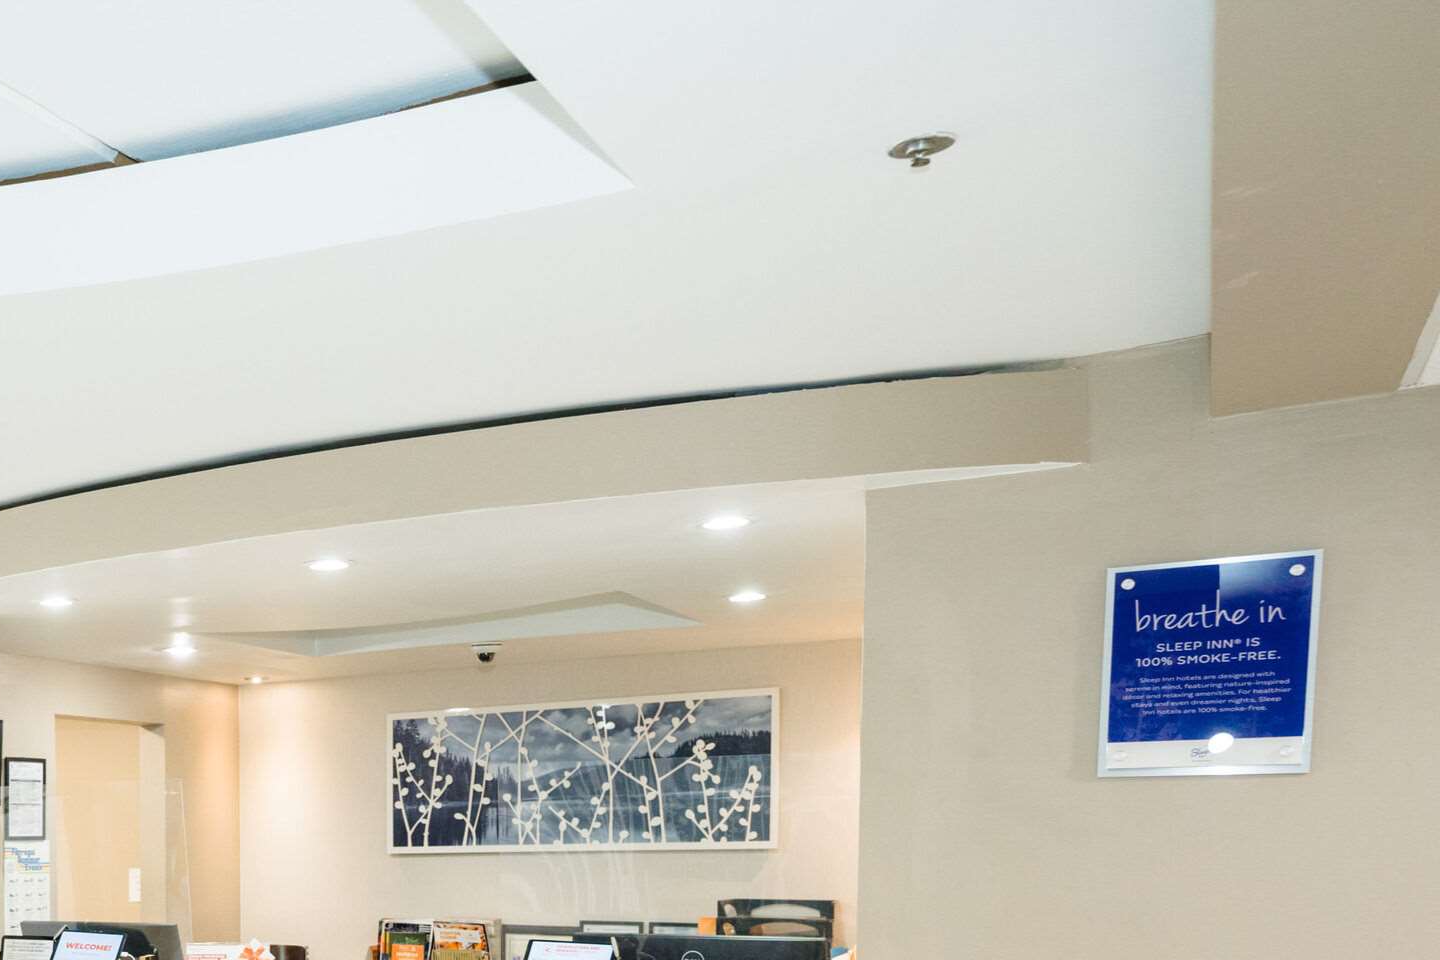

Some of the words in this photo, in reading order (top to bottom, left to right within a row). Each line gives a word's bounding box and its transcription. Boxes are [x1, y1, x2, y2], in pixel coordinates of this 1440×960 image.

[1135, 589, 1249, 632] breathe
[1259, 600, 1287, 623] in
[1156, 641, 1202, 653] SLEEP
[1246, 637, 1261, 647] IS
[1135, 656, 1173, 668] 100%
[1177, 650, 1281, 666] SMOKE-FREE.
[1139, 676, 1161, 685] Sleep
[1176, 674, 1202, 682] hotels
[1218, 671, 1255, 681] designed
[1184, 681, 1223, 690] featuring
